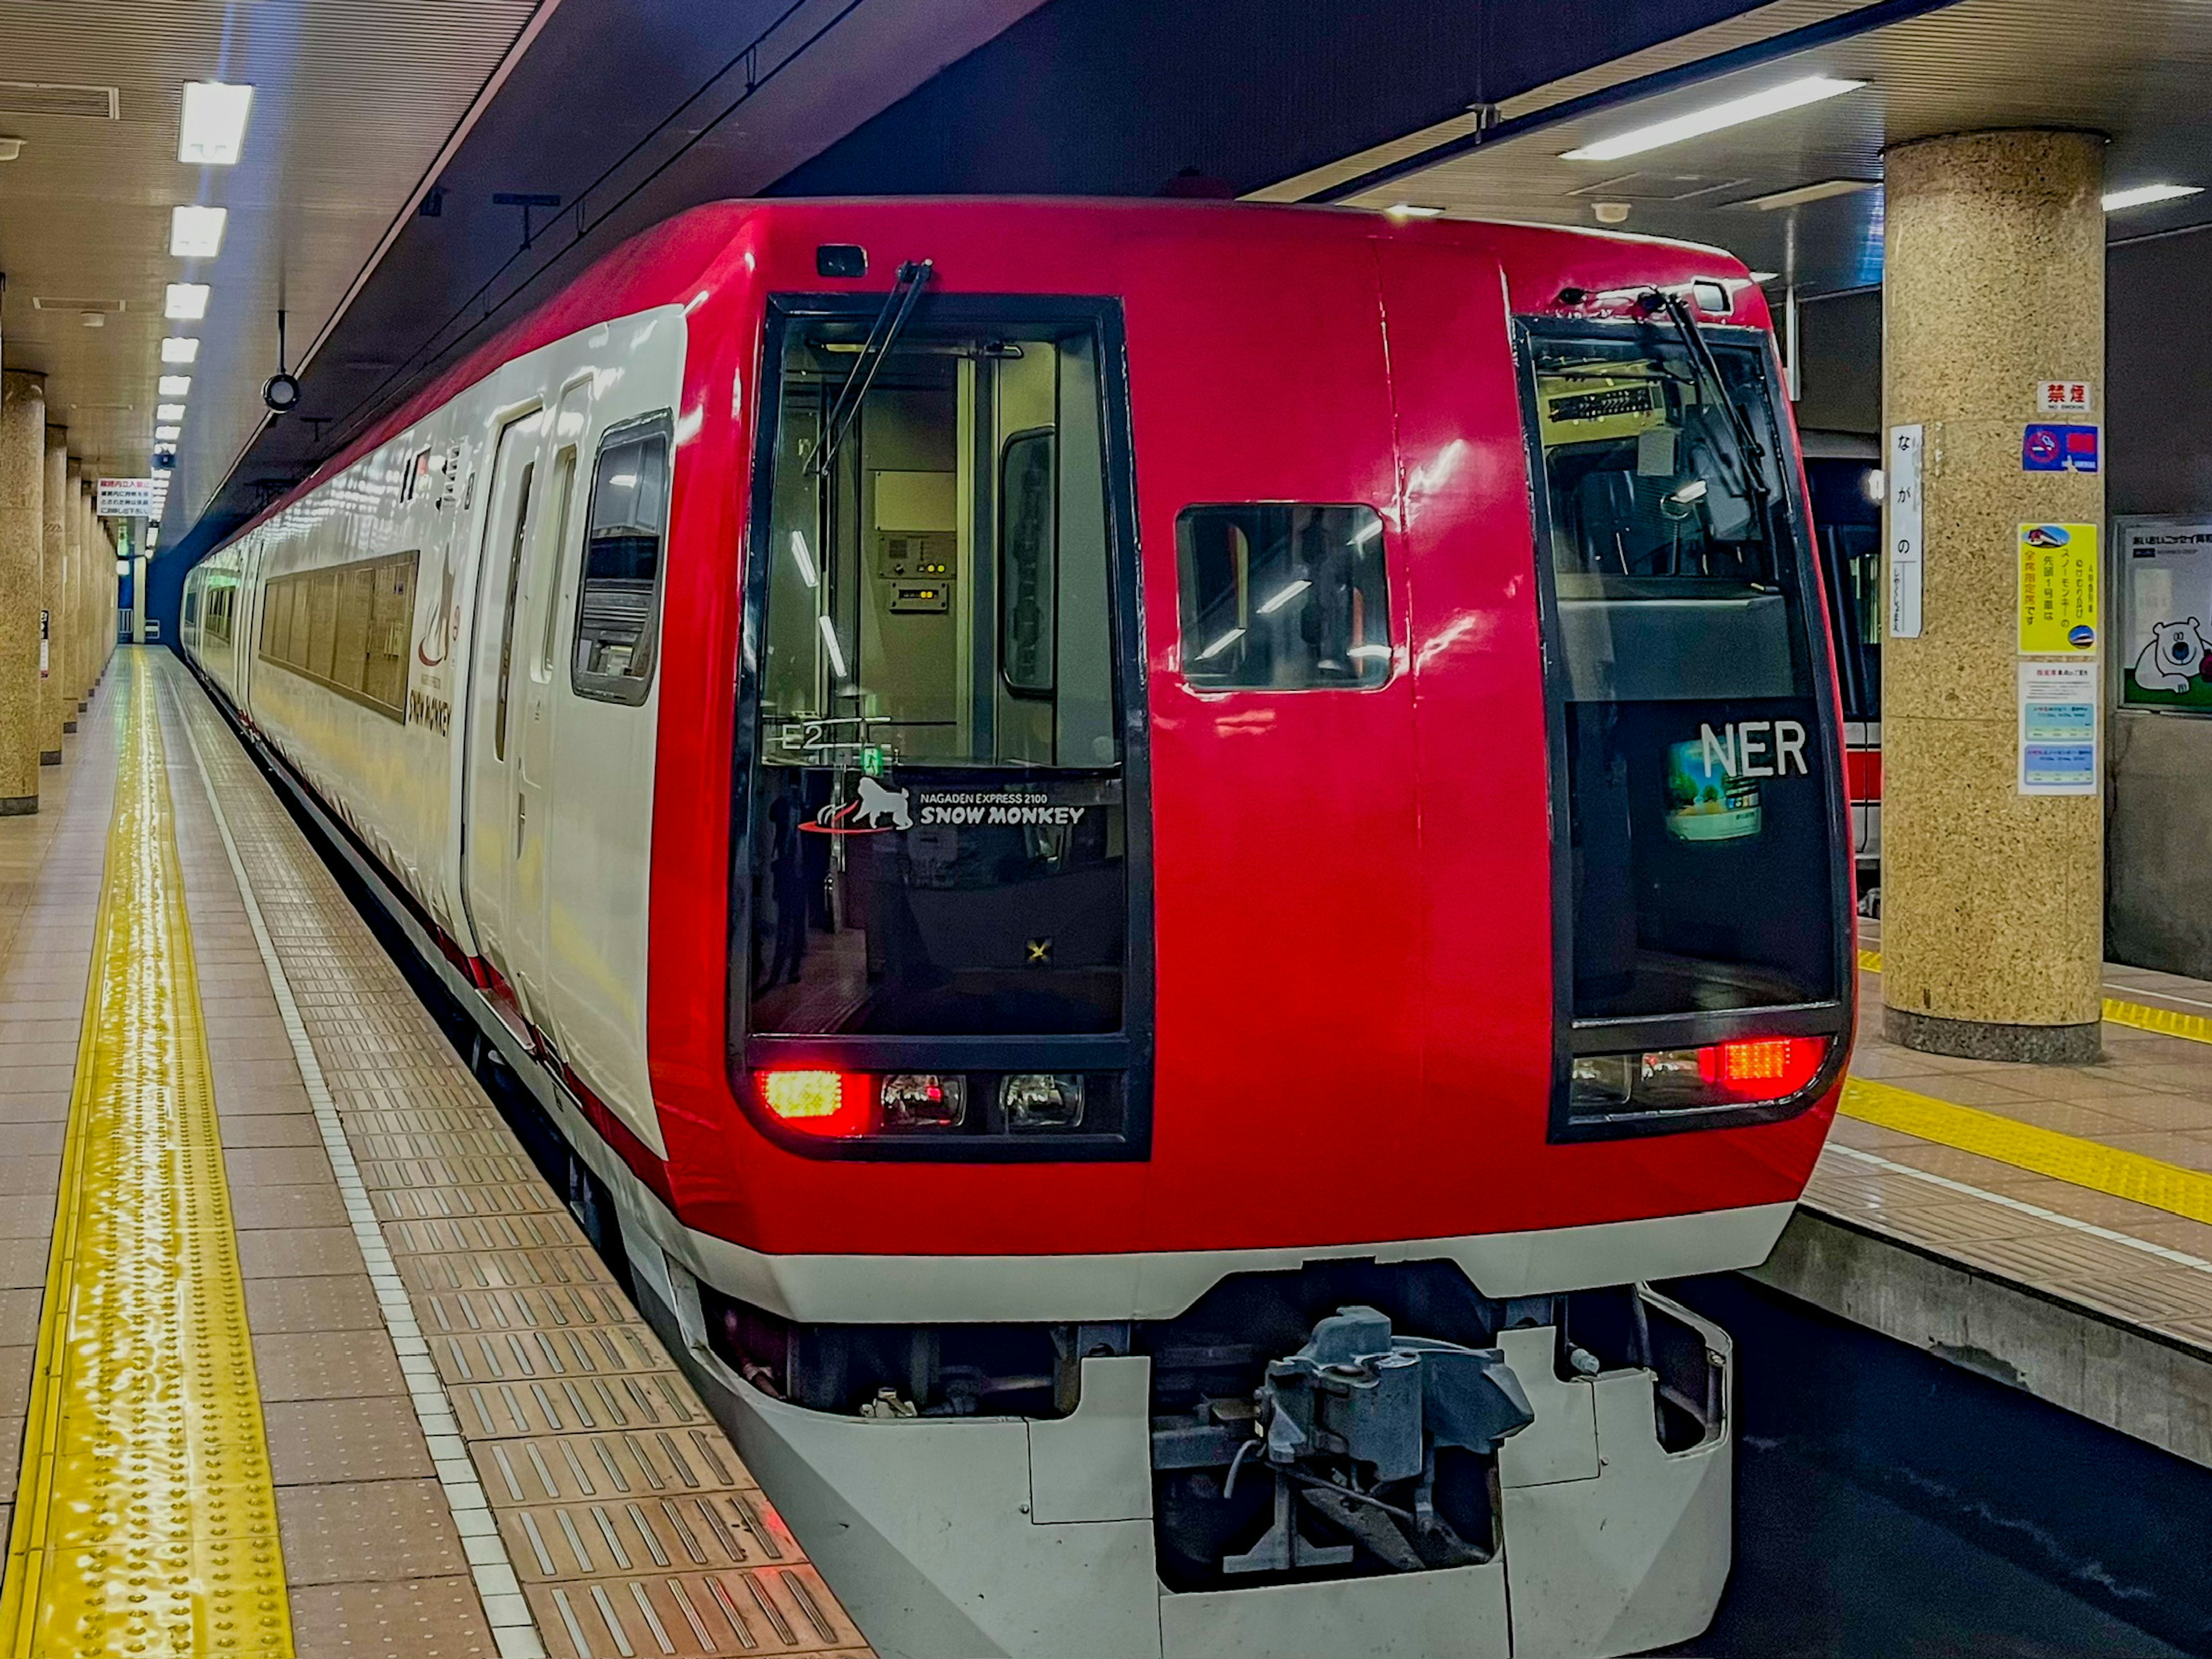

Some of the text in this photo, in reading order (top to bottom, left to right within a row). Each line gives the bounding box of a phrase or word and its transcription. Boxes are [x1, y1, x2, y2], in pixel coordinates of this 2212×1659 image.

[2047, 384, 2085, 403] 禁煙
[1897, 435, 1911, 554] ながの
[2061, 548, 2070, 628] スノーモンキーの
[782, 724, 823, 749] E2
[1700, 720, 1808, 778] NER
[920, 793, 1047, 804] NAGADEN EXPRESS 2100
[921, 806, 1085, 825] SNOW MONKEY
